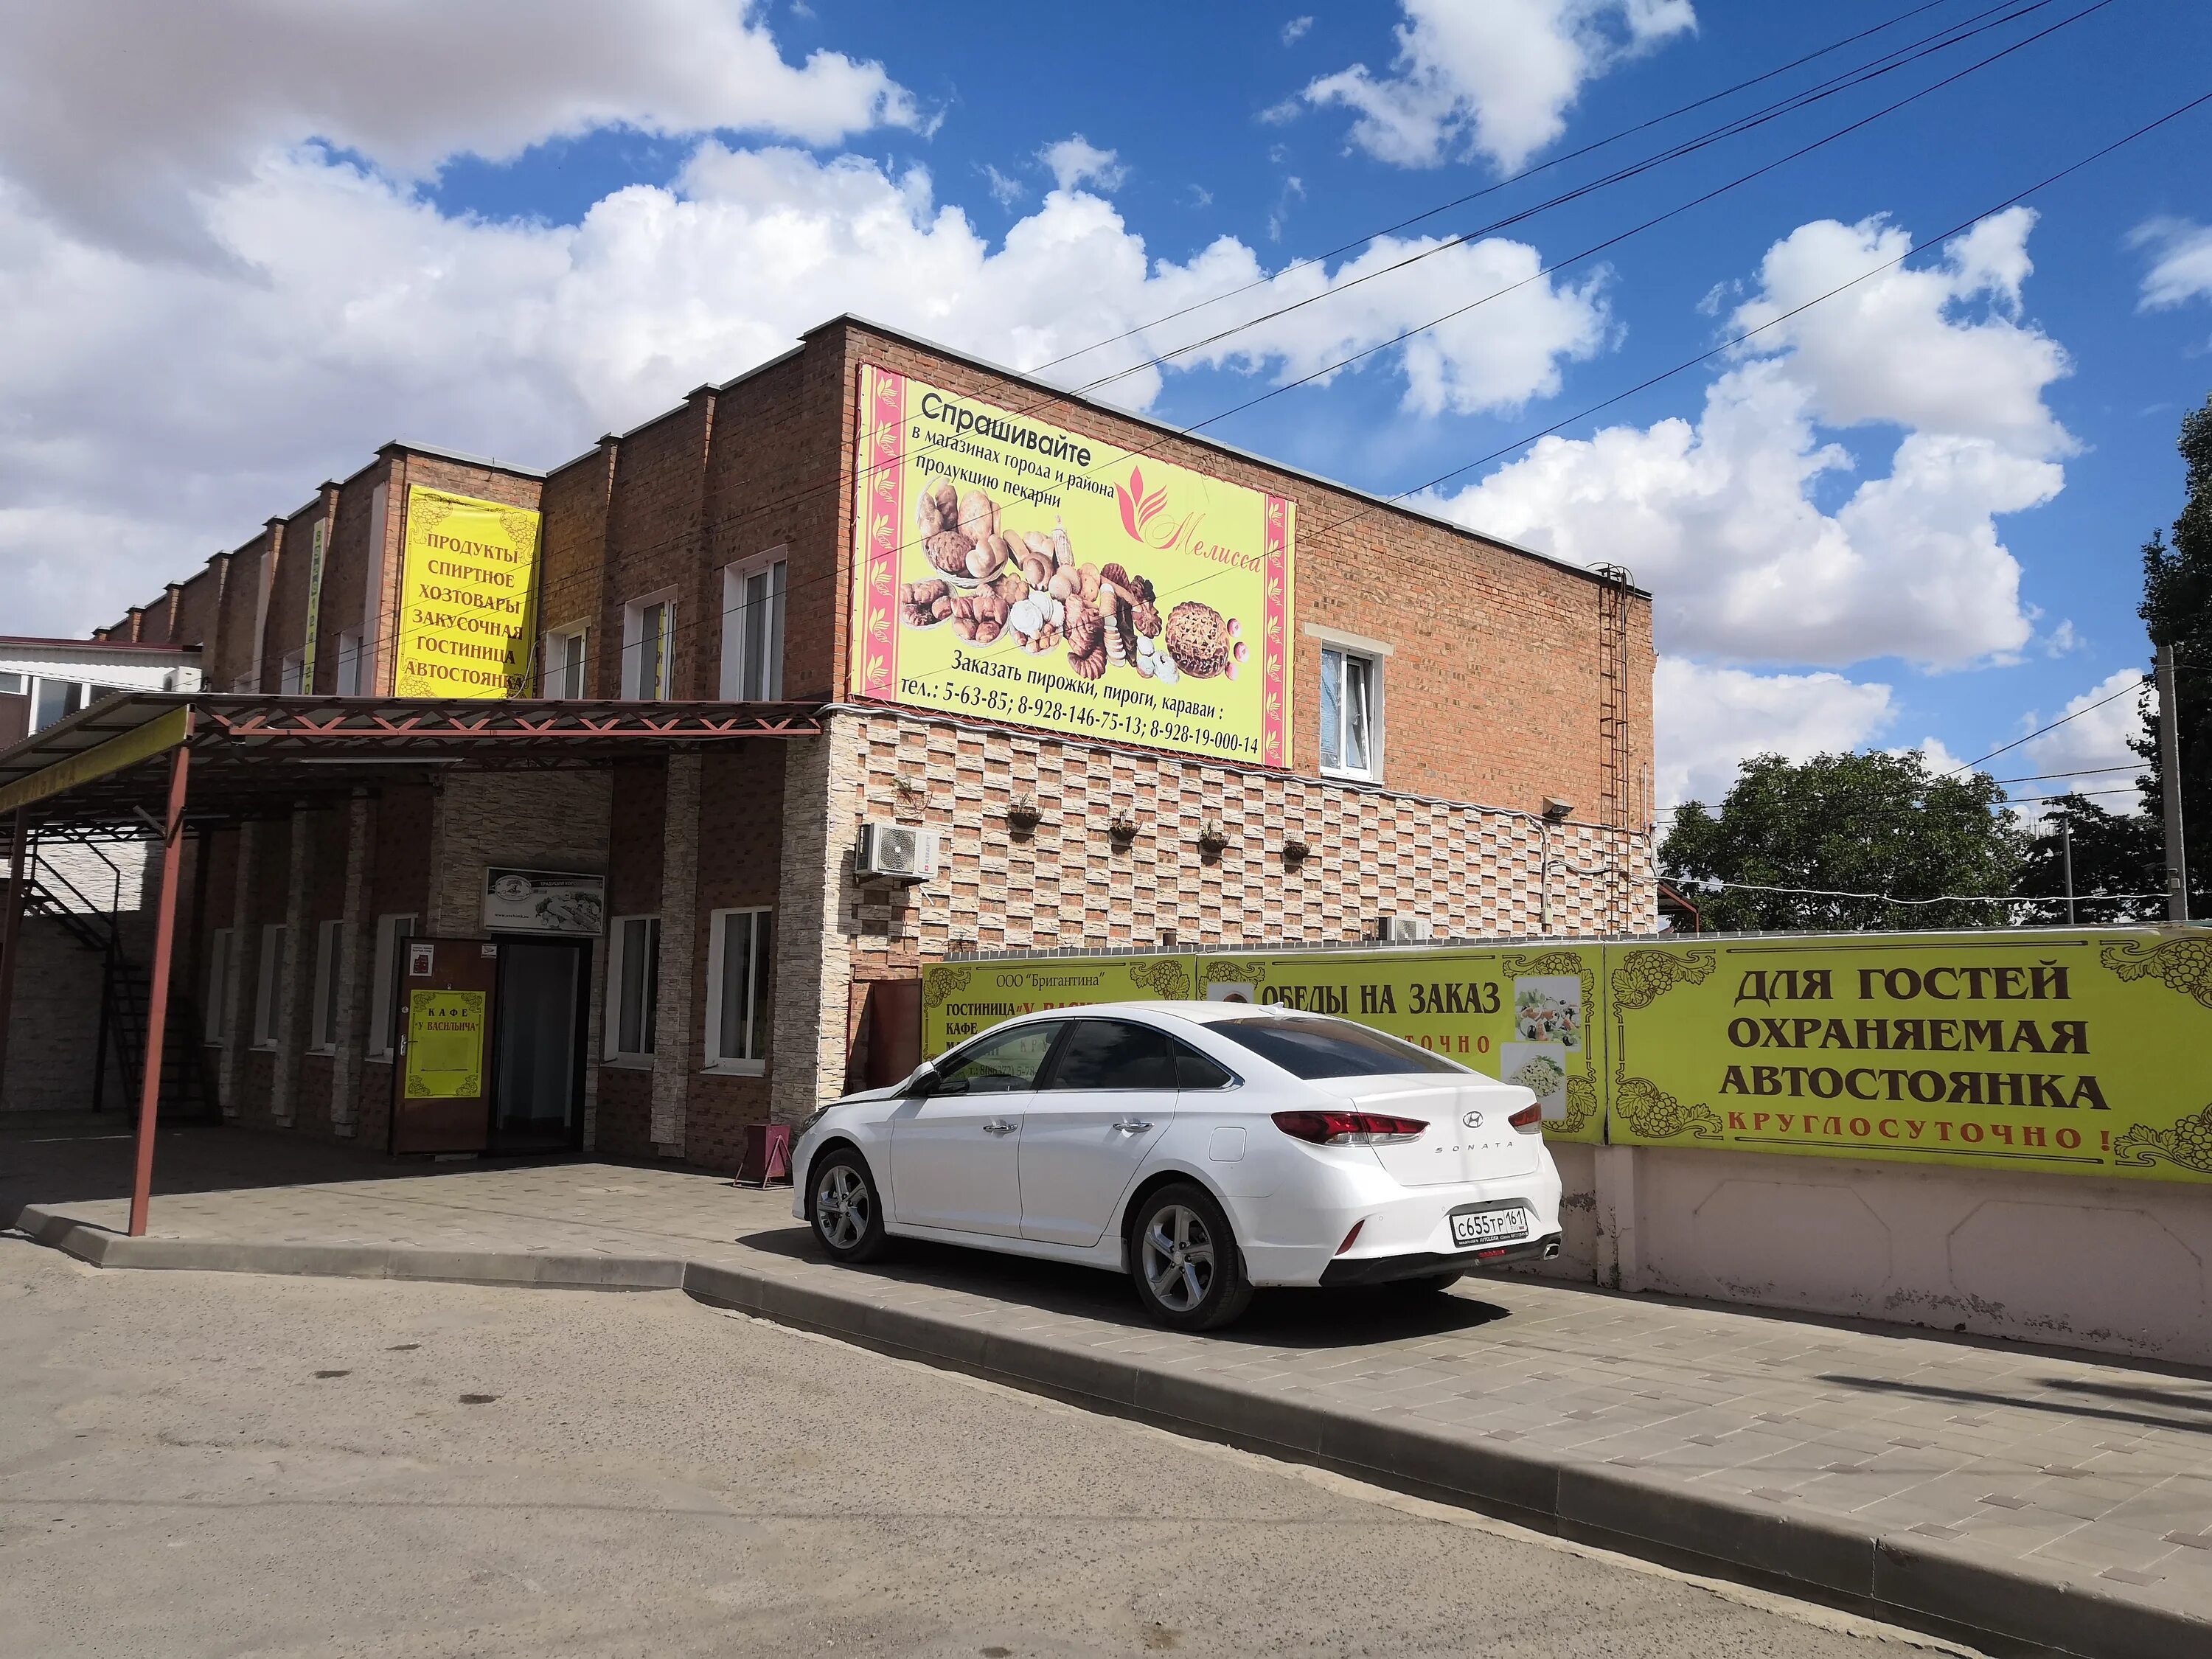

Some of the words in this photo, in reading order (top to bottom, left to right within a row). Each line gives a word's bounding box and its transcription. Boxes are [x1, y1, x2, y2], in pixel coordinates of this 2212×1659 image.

[922, 392, 1091, 467] Спрашивайте
[911, 426, 920, 439] в
[925, 431, 1000, 464] магазинах
[1004, 454, 1051, 479] города
[1055, 470, 1064, 483] и
[1066, 473, 1115, 498] района
[916, 455, 999, 490] продукцию
[1004, 481, 1061, 508] пекарни
[427, 533, 518, 564] ПРОДУКТЫ
[1144, 512, 1261, 573] Мелисса
[428, 560, 515, 588] СПИРТНОЕ
[418, 583, 520, 615] ХОЗТОВАРЫ
[412, 609, 524, 641] ЗАКУСОЧНАЯ
[417, 636, 516, 665] ГОСТИНИЦА
[404, 661, 523, 690] АВТОСТОЯНКА
[951, 650, 1022, 681] Заказать
[1027, 670, 1098, 700] пирожки,
[1103, 685, 1157, 711] пироги,
[1162, 697, 1216, 720] караваи
[901, 678, 939, 698] тел.:
[943, 682, 1014, 716] 5-63-85;
[1018, 695, 1147, 739] 8-928-146-75-13;
[1150, 720, 1259, 754] 8-928-19-000-14
[996, 974, 1023, 988] ООО
[1733, 970, 1834, 1008] ДЛЯ
[1857, 959, 2072, 1001] ГОСТЕЙ
[428, 1008, 468, 1017] КАФЕ
[946, 1003, 1016, 1018] ГОСТИНИЦА
[1262, 985, 1349, 1015] ОБЕДЫ
[1360, 984, 1397, 1015] НА
[1408, 982, 1501, 1015] ЗАКАЗ
[946, 1022, 978, 1035] КАФЕ
[1727, 1018, 2091, 1055] ОХРАНЯЕМАЯ
[1717, 1065, 2112, 1112] АВТОСТОЯНКА
[1434, 1141, 1513, 1153] SONATA
[1727, 1110, 2081, 1150] КРУГЛОСУТОЧНО
[2099, 1130, 2111, 1152] !
[1505, 1210, 1523, 1225] 161
